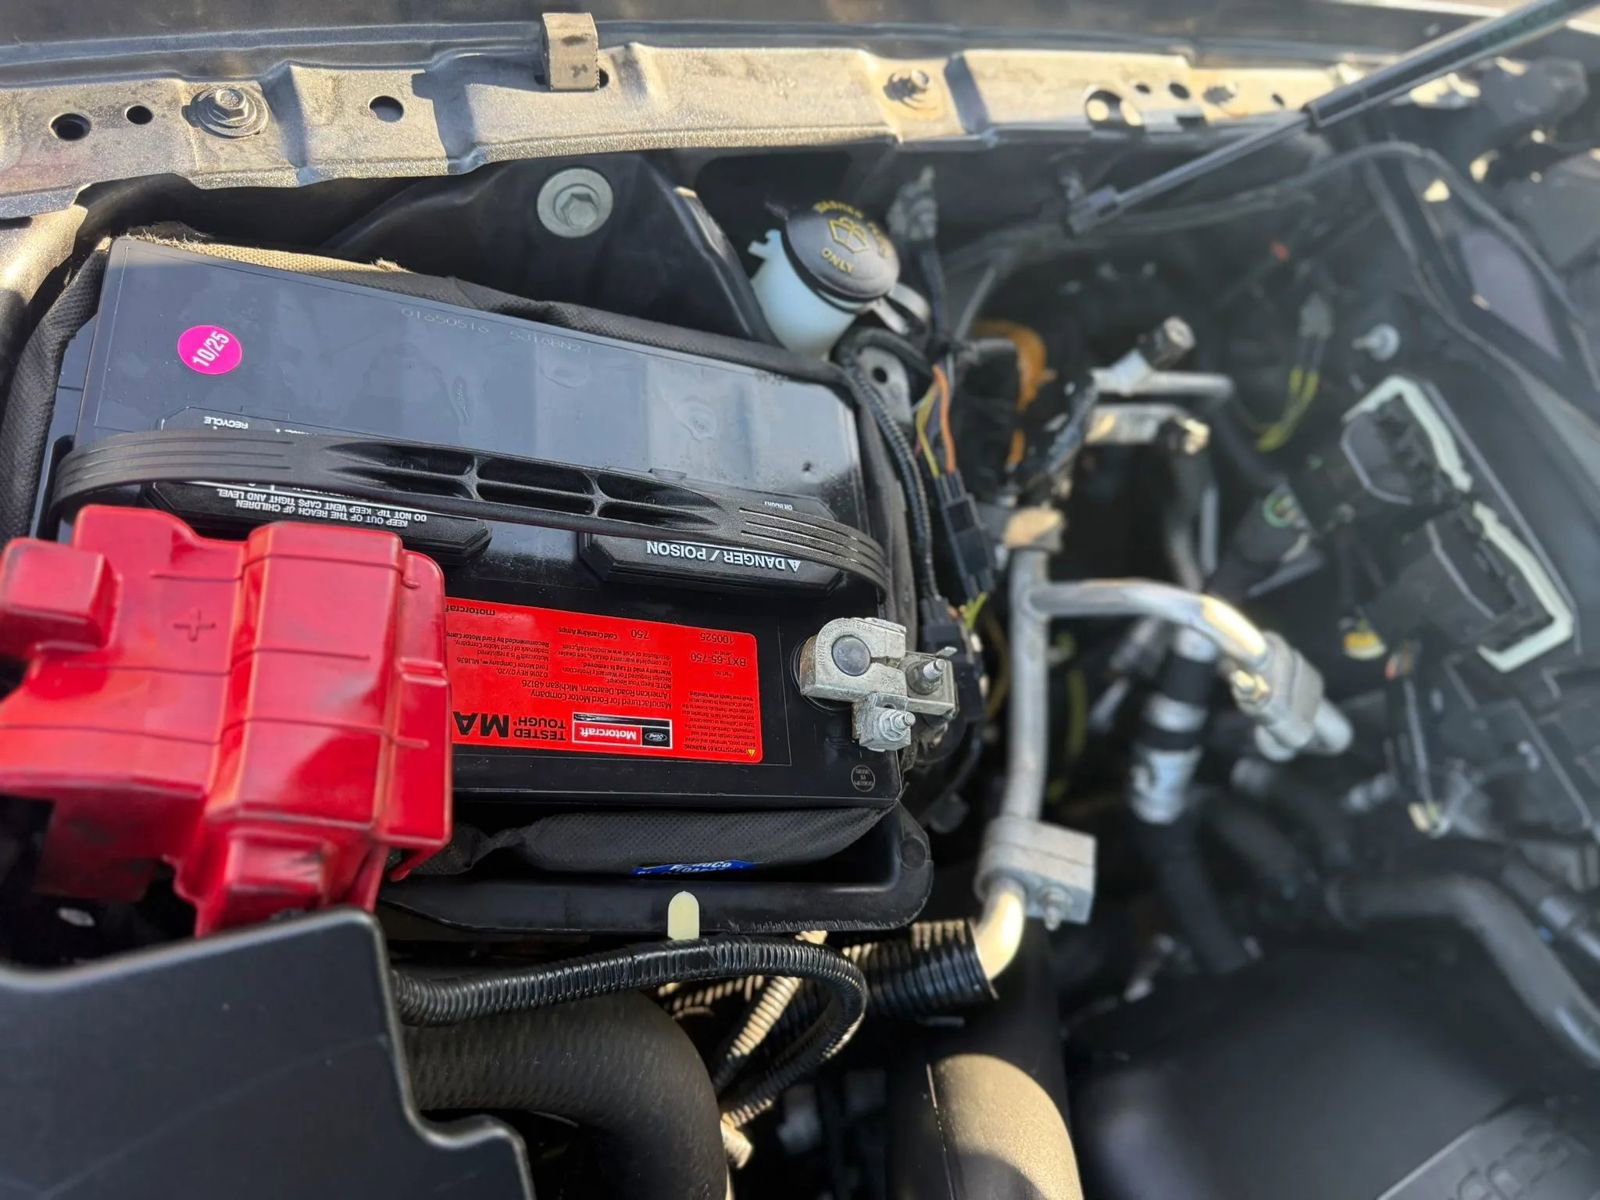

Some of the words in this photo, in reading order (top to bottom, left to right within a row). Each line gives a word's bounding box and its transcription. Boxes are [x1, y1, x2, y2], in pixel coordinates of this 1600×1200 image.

[192, 331, 230, 367] 10/25
[204, 416, 248, 429] RECYCLE
[216, 488, 244, 499] LEVEL
[247, 492, 266, 502] AND
[269, 495, 295, 505] TIGHT
[299, 499, 321, 508] CAPS
[236, 500, 280, 512] CHILDREN
[325, 502, 346, 512] VENT
[349, 506, 371, 515] KEEP
[299, 507, 328, 518] REACH
[330, 511, 348, 520] THE
[376, 509, 391, 518] TIP.
[395, 511, 411, 520] NOT
[366, 516, 384, 524] OUT
[646, 541, 706, 560] POISON
[723, 551, 785, 570] DANGER
[446, 604, 495, 617] motorcraf
[577, 629, 603, 638] Cranking
[631, 629, 649, 640] 750
[700, 633, 732, 644] 100525
[691, 653, 746, 666] BXT-65-750
[647, 668, 672, 676] Warranty
[545, 682, 577, 692] Michigan
[531, 690, 567, 700] Company
[568, 694, 590, 703] Motor
[636, 690, 667, 699] American
[591, 696, 608, 705] Ford
[622, 699, 672, 709] Manufactured
[453, 711, 510, 738] MA
[514, 729, 565, 741] TESTED
[580, 727, 636, 740] Motorcraft
